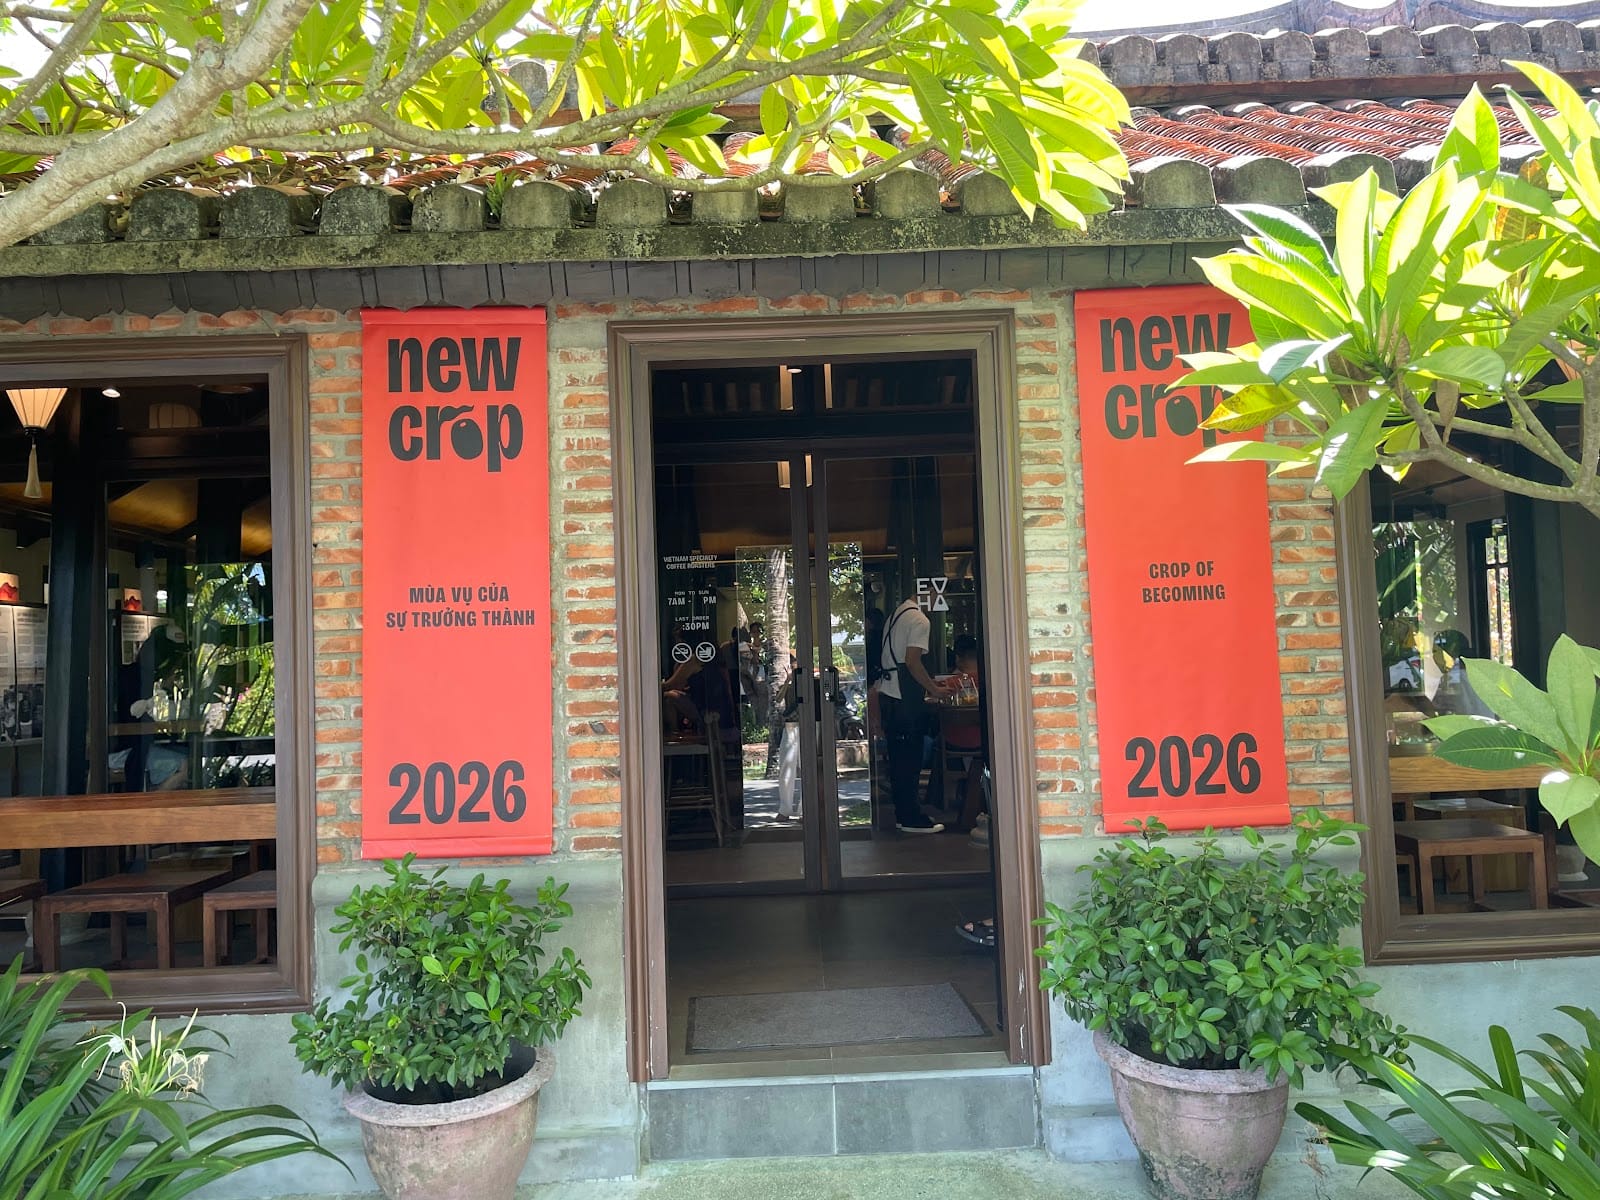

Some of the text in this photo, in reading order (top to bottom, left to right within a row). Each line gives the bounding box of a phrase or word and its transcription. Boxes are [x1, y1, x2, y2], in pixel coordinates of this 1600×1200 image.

[1100, 313, 1232, 373] new
[388, 337, 522, 393] new
[389, 404, 523, 473] crop
[663, 554, 718, 563] VIETNAM SPECIALTY
[1150, 560, 1215, 579] CROP OF
[409, 583, 509, 605] MÙA VỤ CỦA
[667, 597, 686, 606] 7AM
[703, 596, 717, 604] PM
[1143, 585, 1226, 603] BECOMING
[386, 607, 535, 631] SỰ TRƯỞNG THÀNH
[1126, 733, 1262, 798] 2026
[389, 761, 527, 825] 2026
